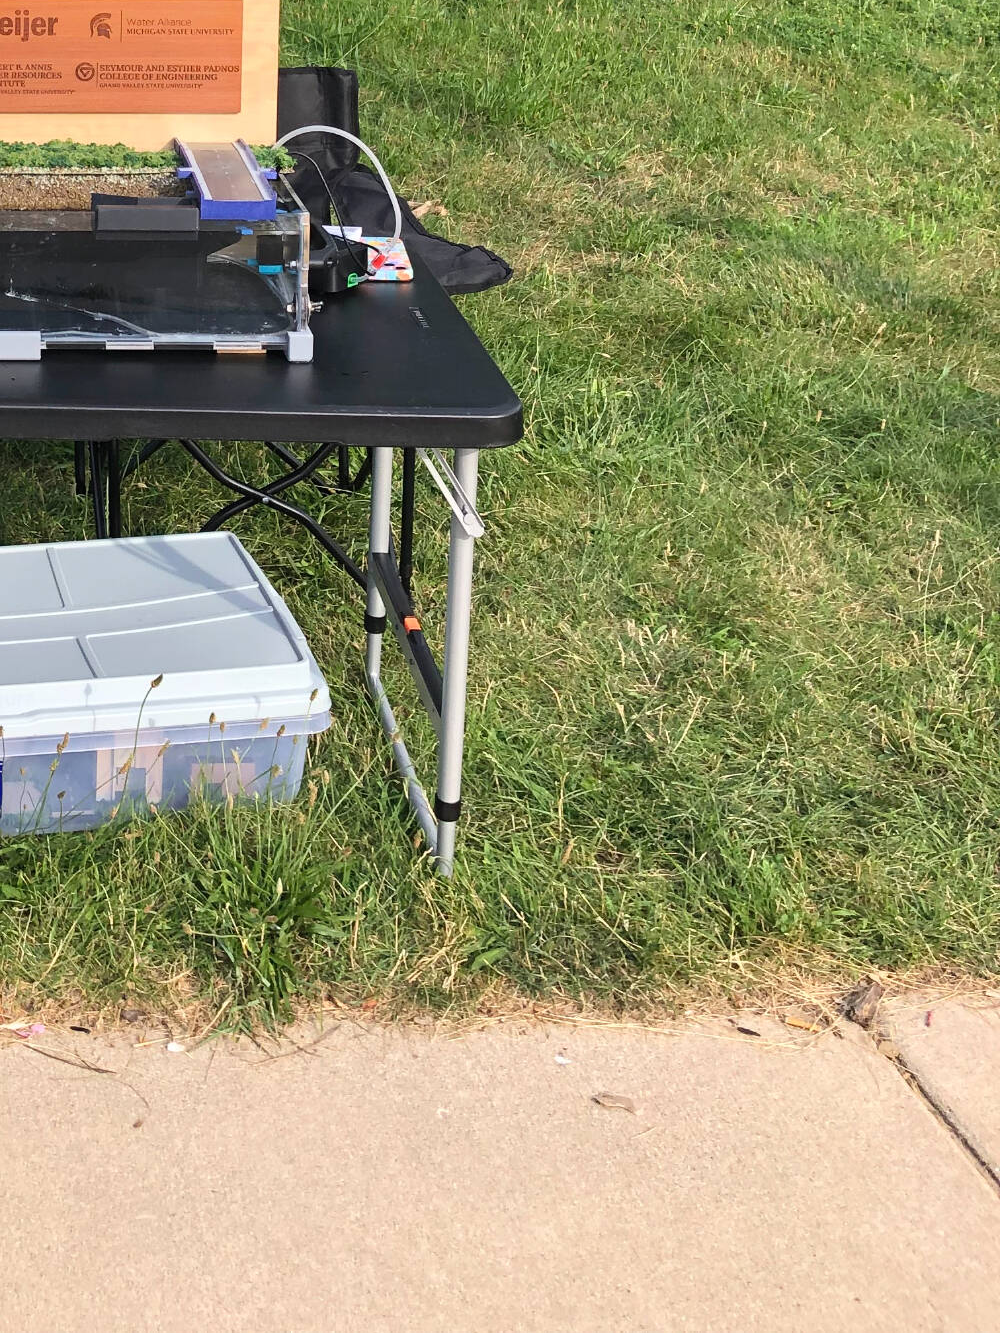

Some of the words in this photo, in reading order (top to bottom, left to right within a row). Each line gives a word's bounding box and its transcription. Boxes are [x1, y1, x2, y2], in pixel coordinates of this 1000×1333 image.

[127, 18, 155, 26] Water
[157, 18, 193, 26] Alliance
[203, 65, 240, 73] PADNOS
[142, 73, 154, 81] OF
[156, 73, 218, 81] ENGINEERING
